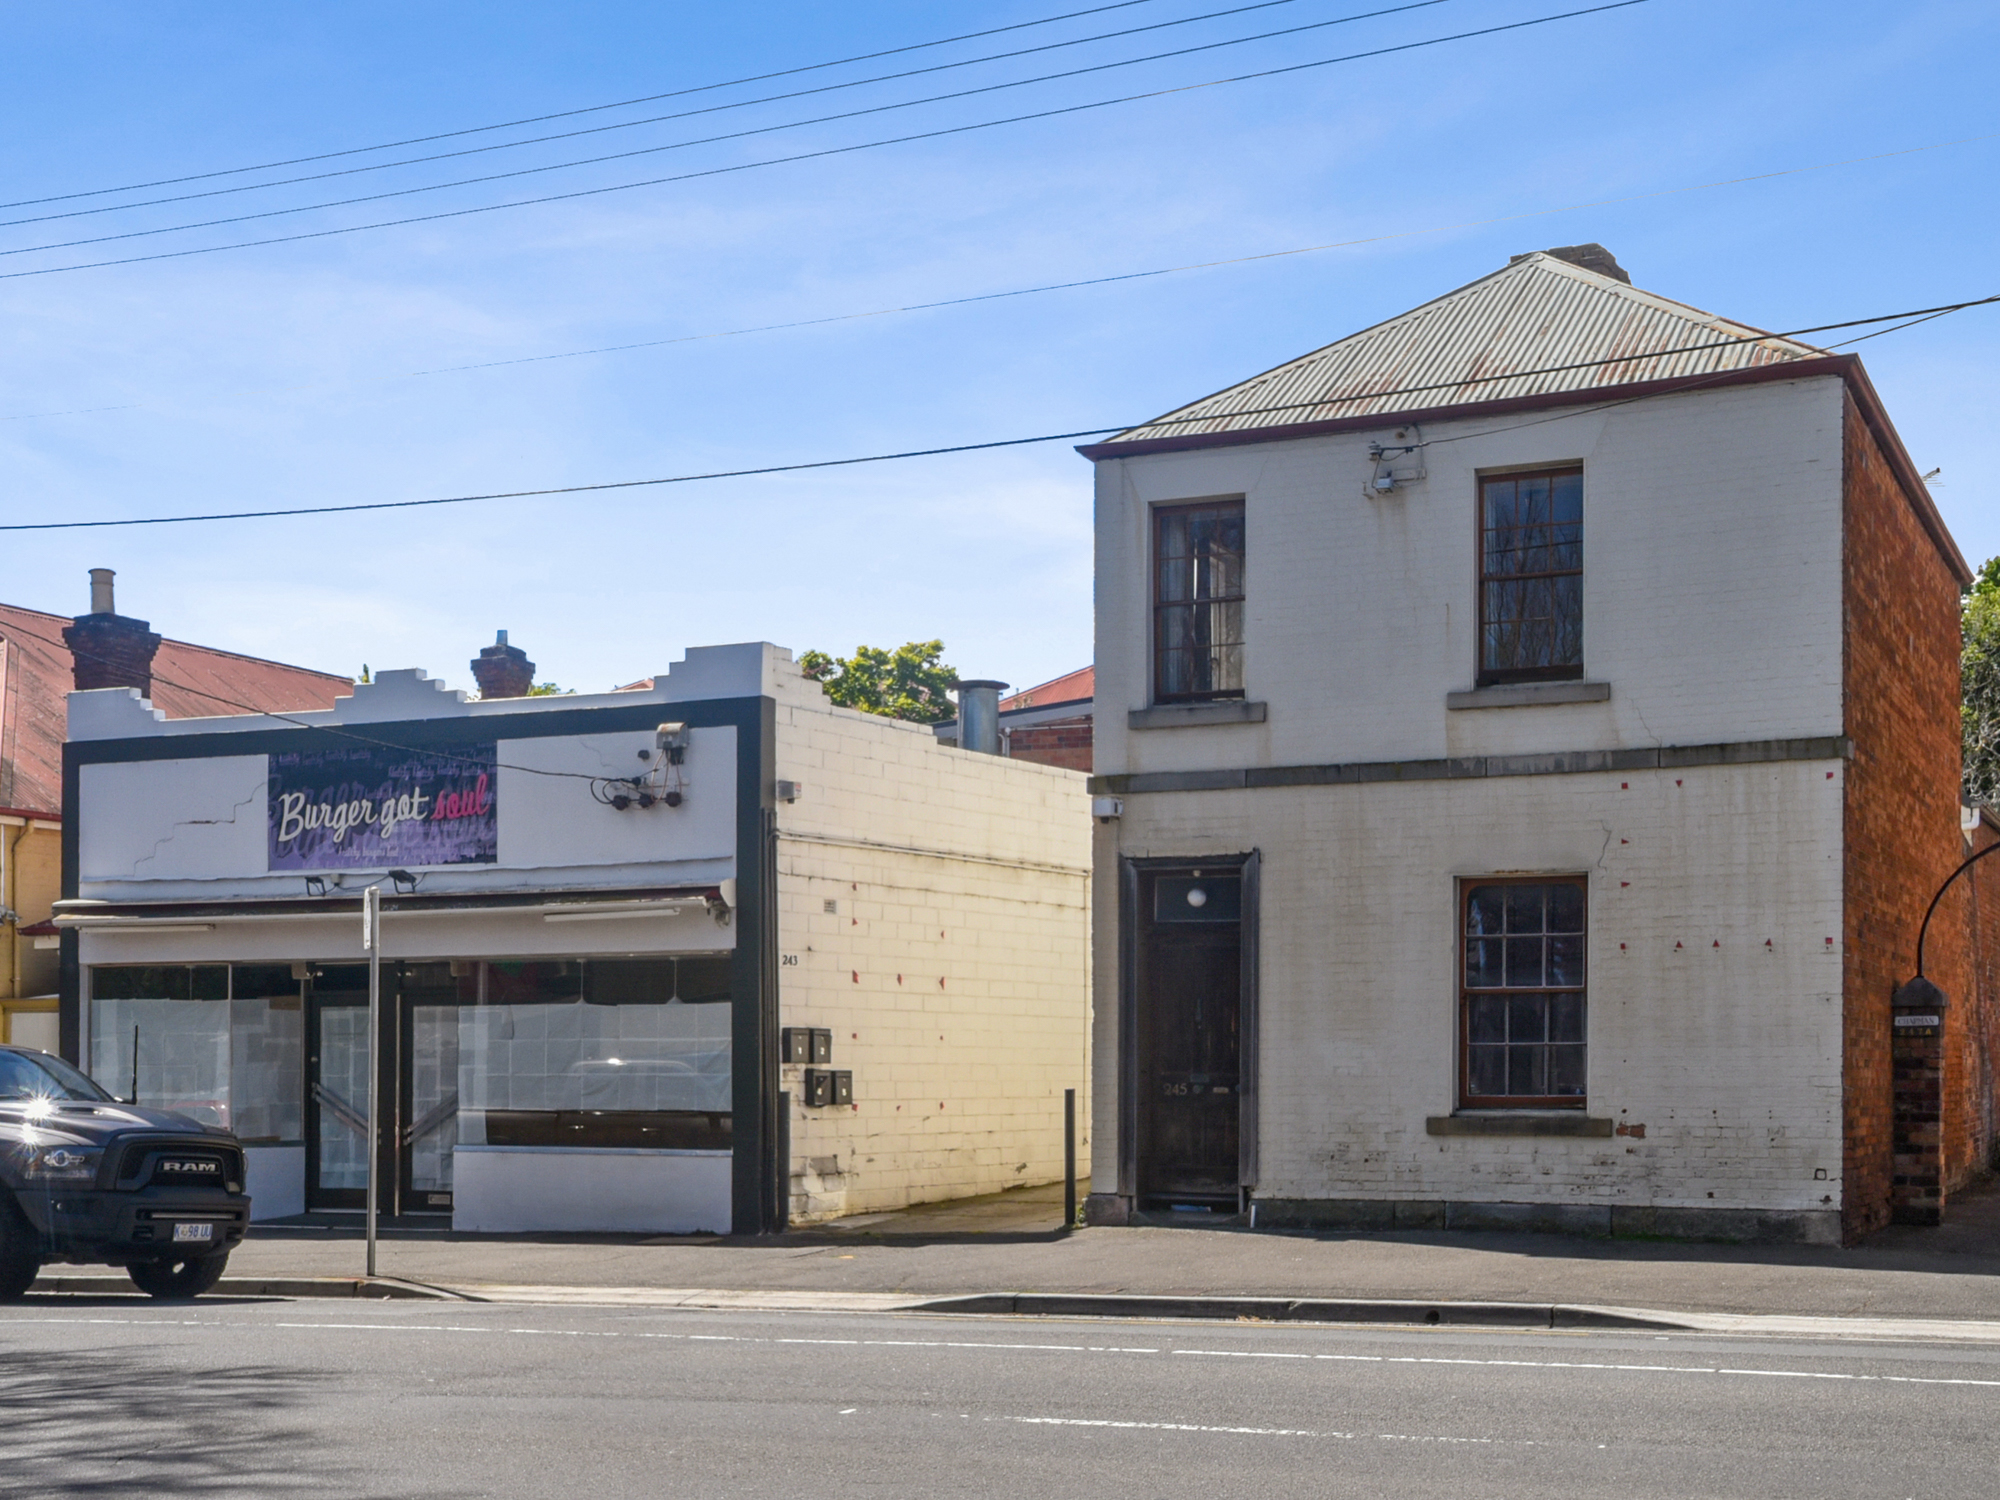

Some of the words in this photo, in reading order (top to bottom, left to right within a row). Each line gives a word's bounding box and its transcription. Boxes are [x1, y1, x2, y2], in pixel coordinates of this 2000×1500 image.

[278, 792, 378, 843] Burger
[380, 786, 430, 839] got
[431, 773, 489, 820] soul
[782, 955, 798, 966] 243
[1163, 1083, 1187, 1095] 245
[163, 1162, 216, 1172] RAM
